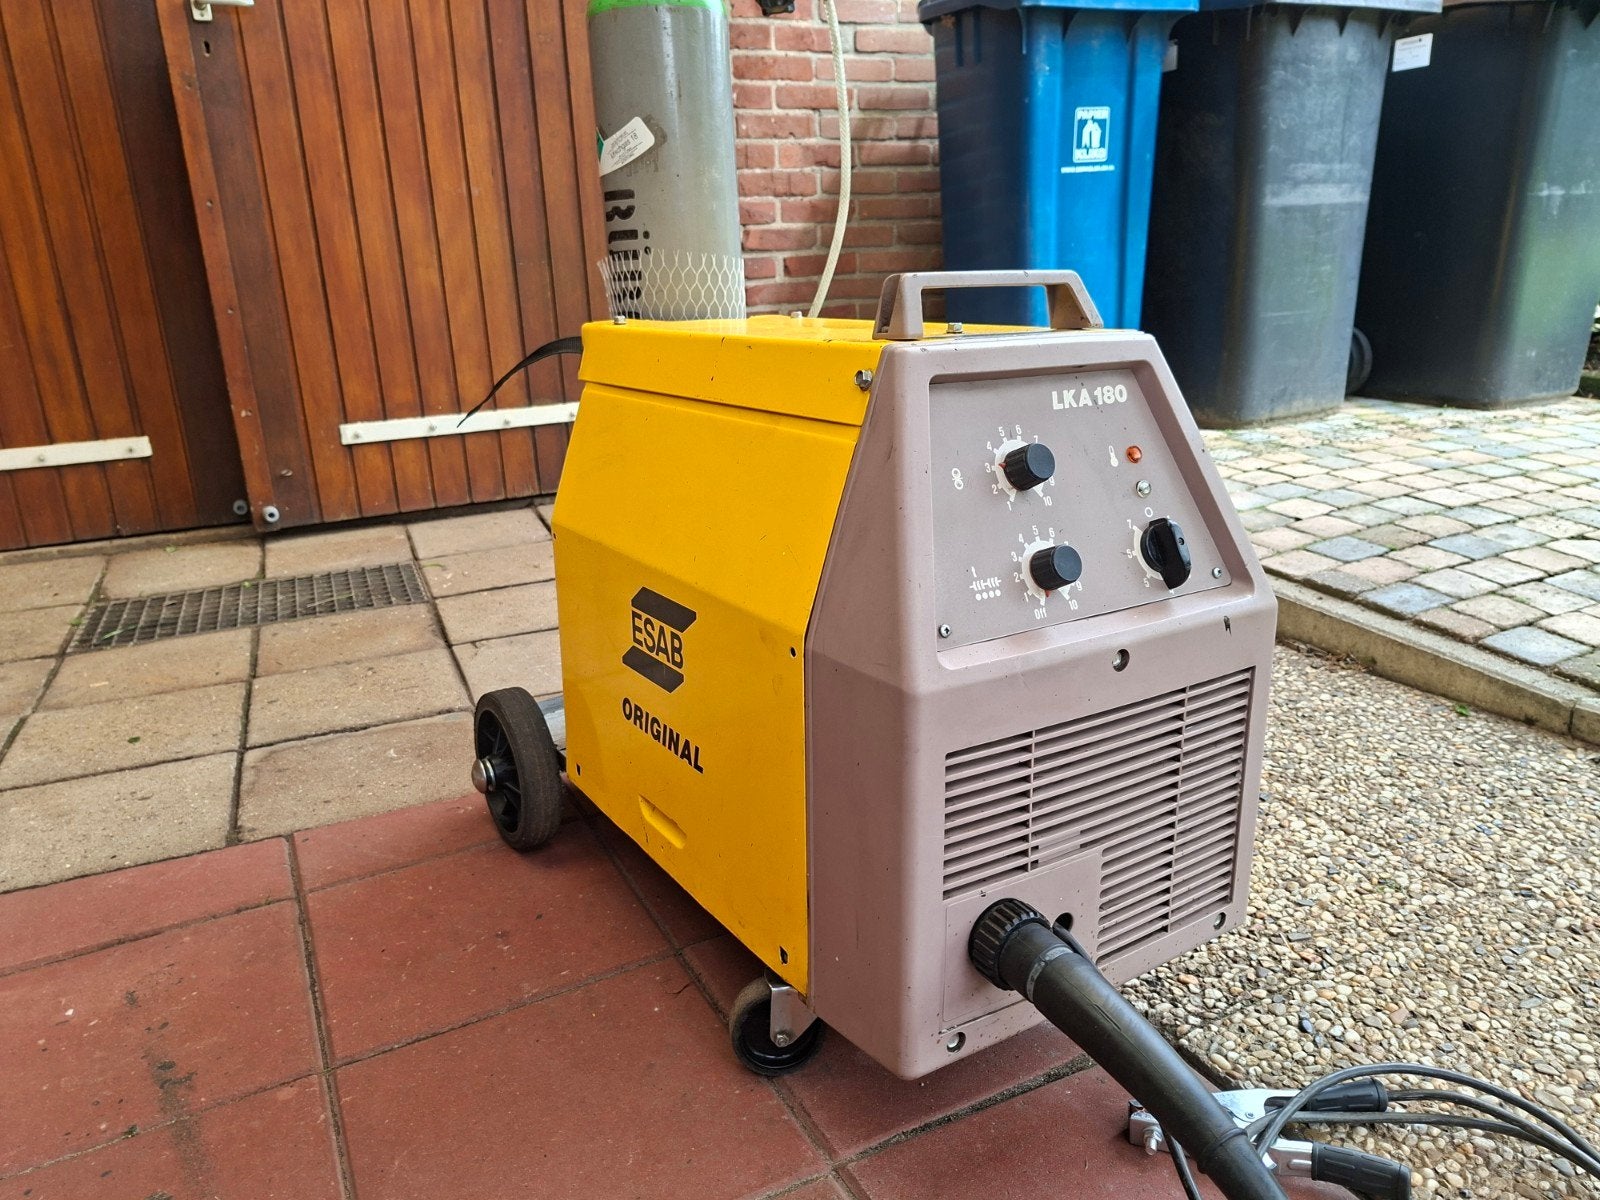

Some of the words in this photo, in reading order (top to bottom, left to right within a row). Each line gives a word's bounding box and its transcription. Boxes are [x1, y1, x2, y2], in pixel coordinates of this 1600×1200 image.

[1051, 389, 1093, 411] LKA
[1093, 384, 1128, 406] 180
[998, 426, 1005, 437] 5
[1015, 424, 1022, 435] 6
[1033, 435, 1039, 443] 7
[986, 441, 993, 451] 4
[984, 462, 991, 473] 3
[991, 484, 999, 495] 2
[1006, 500, 1012, 511] 1
[1043, 495, 1053, 507] 10
[1126, 519, 1132, 529] 7
[1032, 524, 1039, 536] 5
[1048, 527, 1055, 538] 6
[1018, 533, 1025, 544] 4
[1010, 551, 1018, 562] 3
[1013, 572, 1020, 583] 2
[1143, 577, 1150, 588] 5
[1075, 580, 1083, 591] 9
[1023, 592, 1029, 603] 1
[1068, 599, 1079, 611] 10
[1033, 607, 1047, 620] Off
[631, 609, 684, 670] ESAB
[622, 697, 704, 775] ORIGINAL
